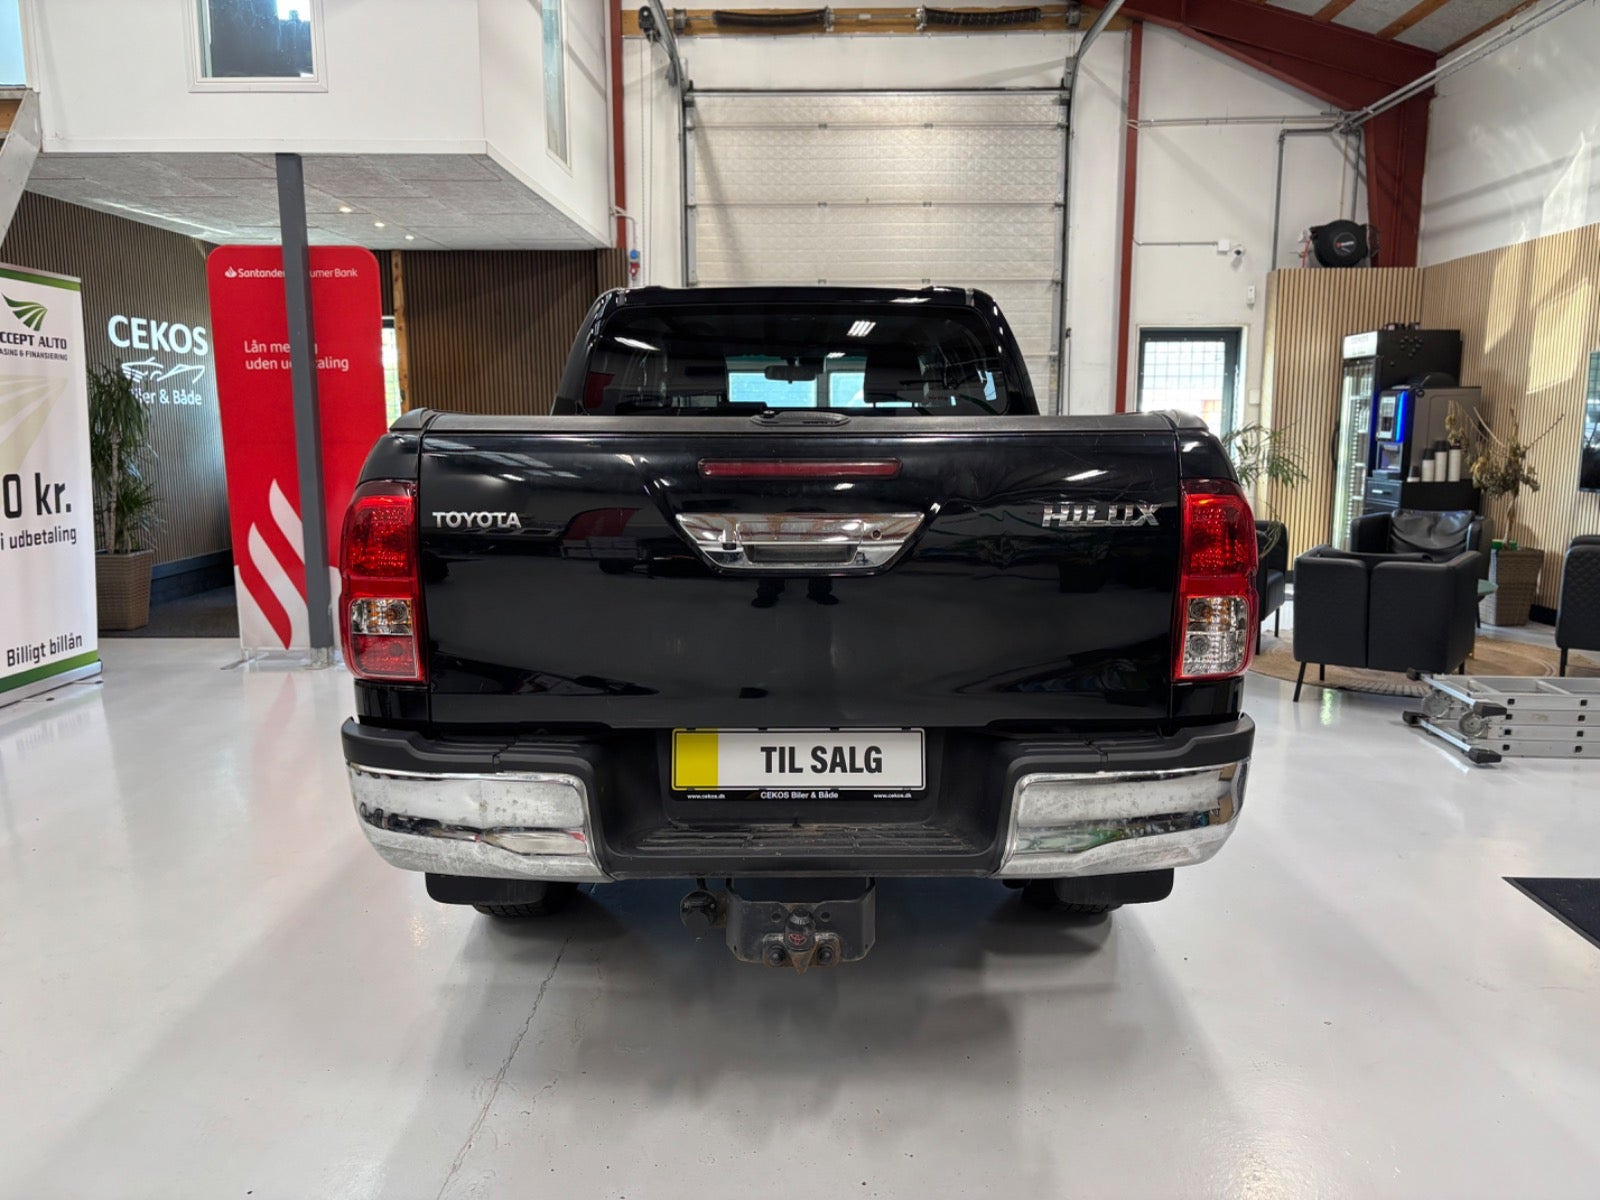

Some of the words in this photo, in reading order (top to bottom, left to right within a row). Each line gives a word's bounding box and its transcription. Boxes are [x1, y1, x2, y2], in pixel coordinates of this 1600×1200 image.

[335, 267, 358, 278] Bank
[0, 331, 35, 346] CCEPT
[38, 335, 68, 350] AUTO
[108, 314, 209, 356] CEKOS
[244, 339, 267, 353] Lån
[270, 343, 291, 353] me
[25, 350, 68, 361] FINANSIERING
[245, 357, 278, 370] uden
[131, 387, 156, 405] iler
[160, 388, 170, 405] &
[173, 389, 203, 405] Både
[35, 472, 72, 516] kr.
[432, 511, 522, 529] TOYOTA
[1042, 503, 1162, 527] HILUX
[9, 526, 77, 549] udbetaling
[7, 643, 46, 667] Billigt
[49, 632, 83, 656] billån
[760, 746, 803, 773] TIL
[810, 745, 883, 773] SALG
[760, 791, 790, 799] CEKOS
[791, 791, 809, 799] Biler
[810, 791, 817, 799] &
[819, 790, 839, 799] Både
